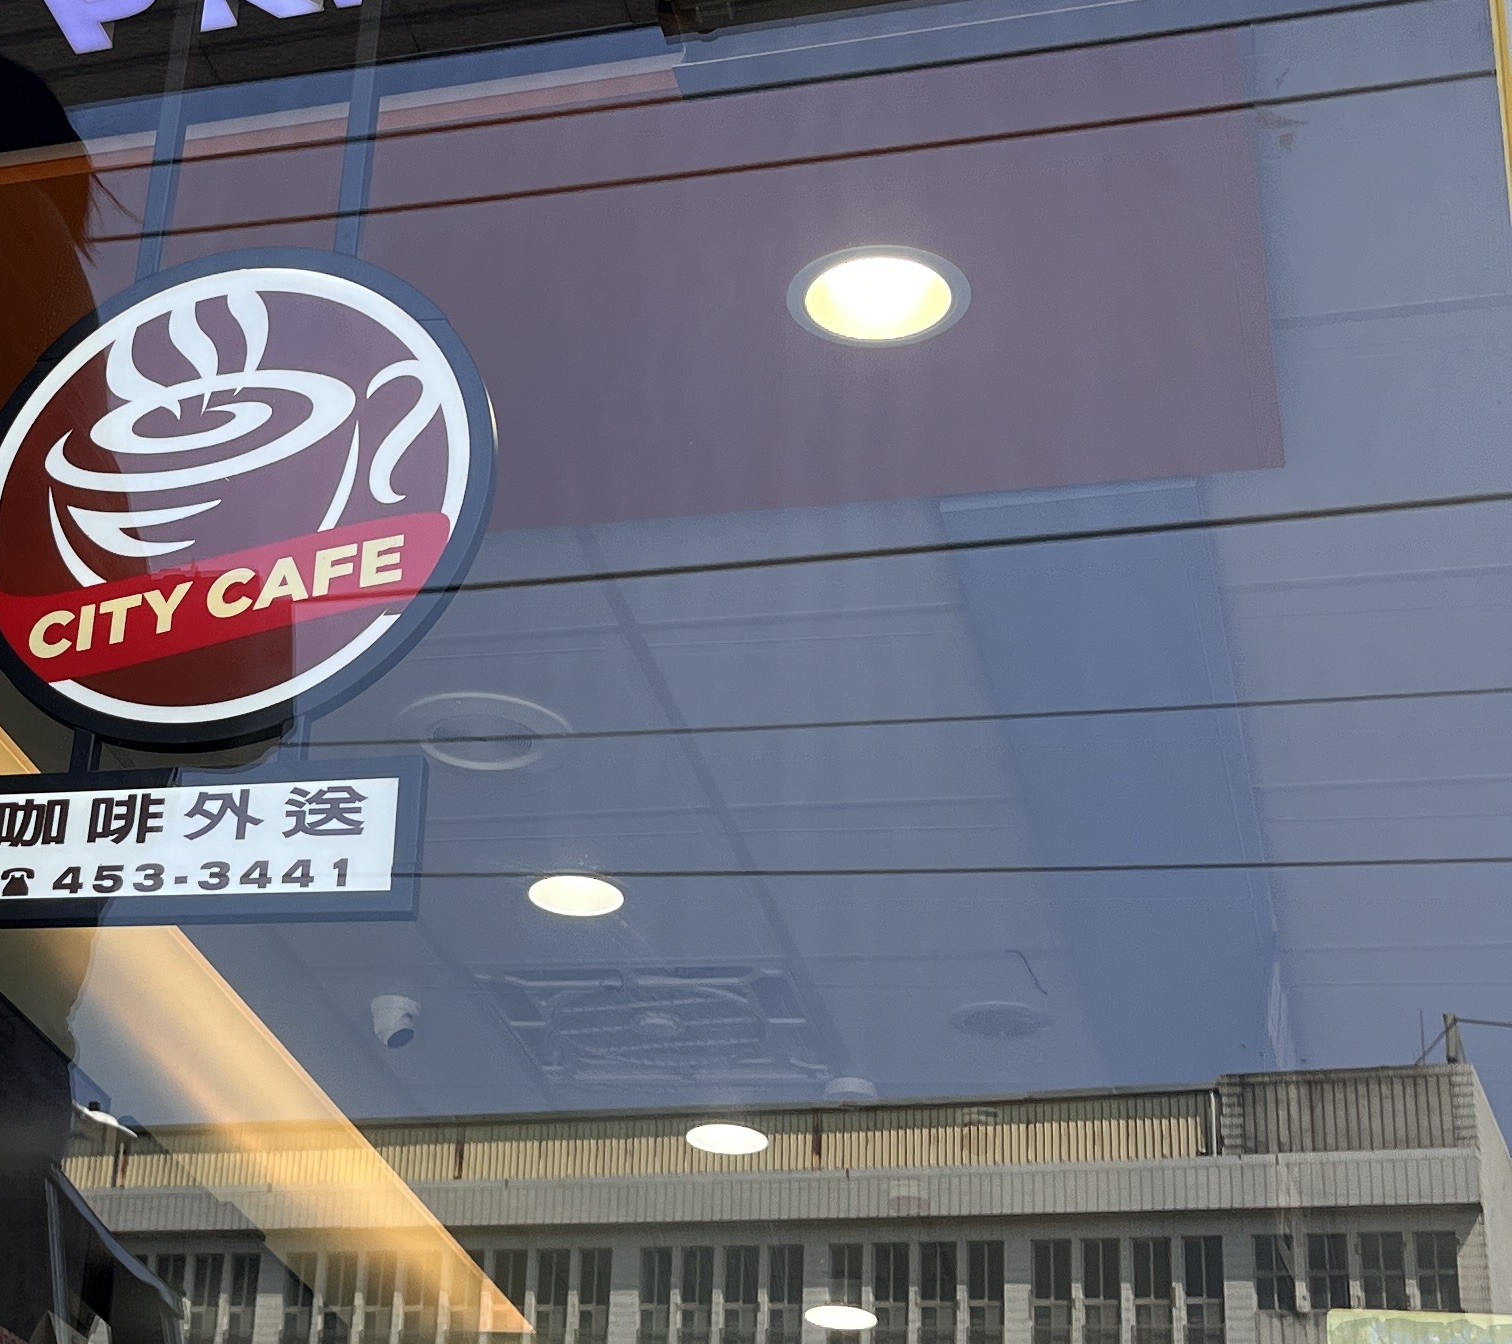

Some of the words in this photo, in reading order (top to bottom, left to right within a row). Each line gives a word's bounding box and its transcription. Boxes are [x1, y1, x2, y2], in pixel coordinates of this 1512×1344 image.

[27, 580, 194, 659] CITY
[206, 533, 407, 620] CAFE
[52, 857, 351, 895] 453-3441
